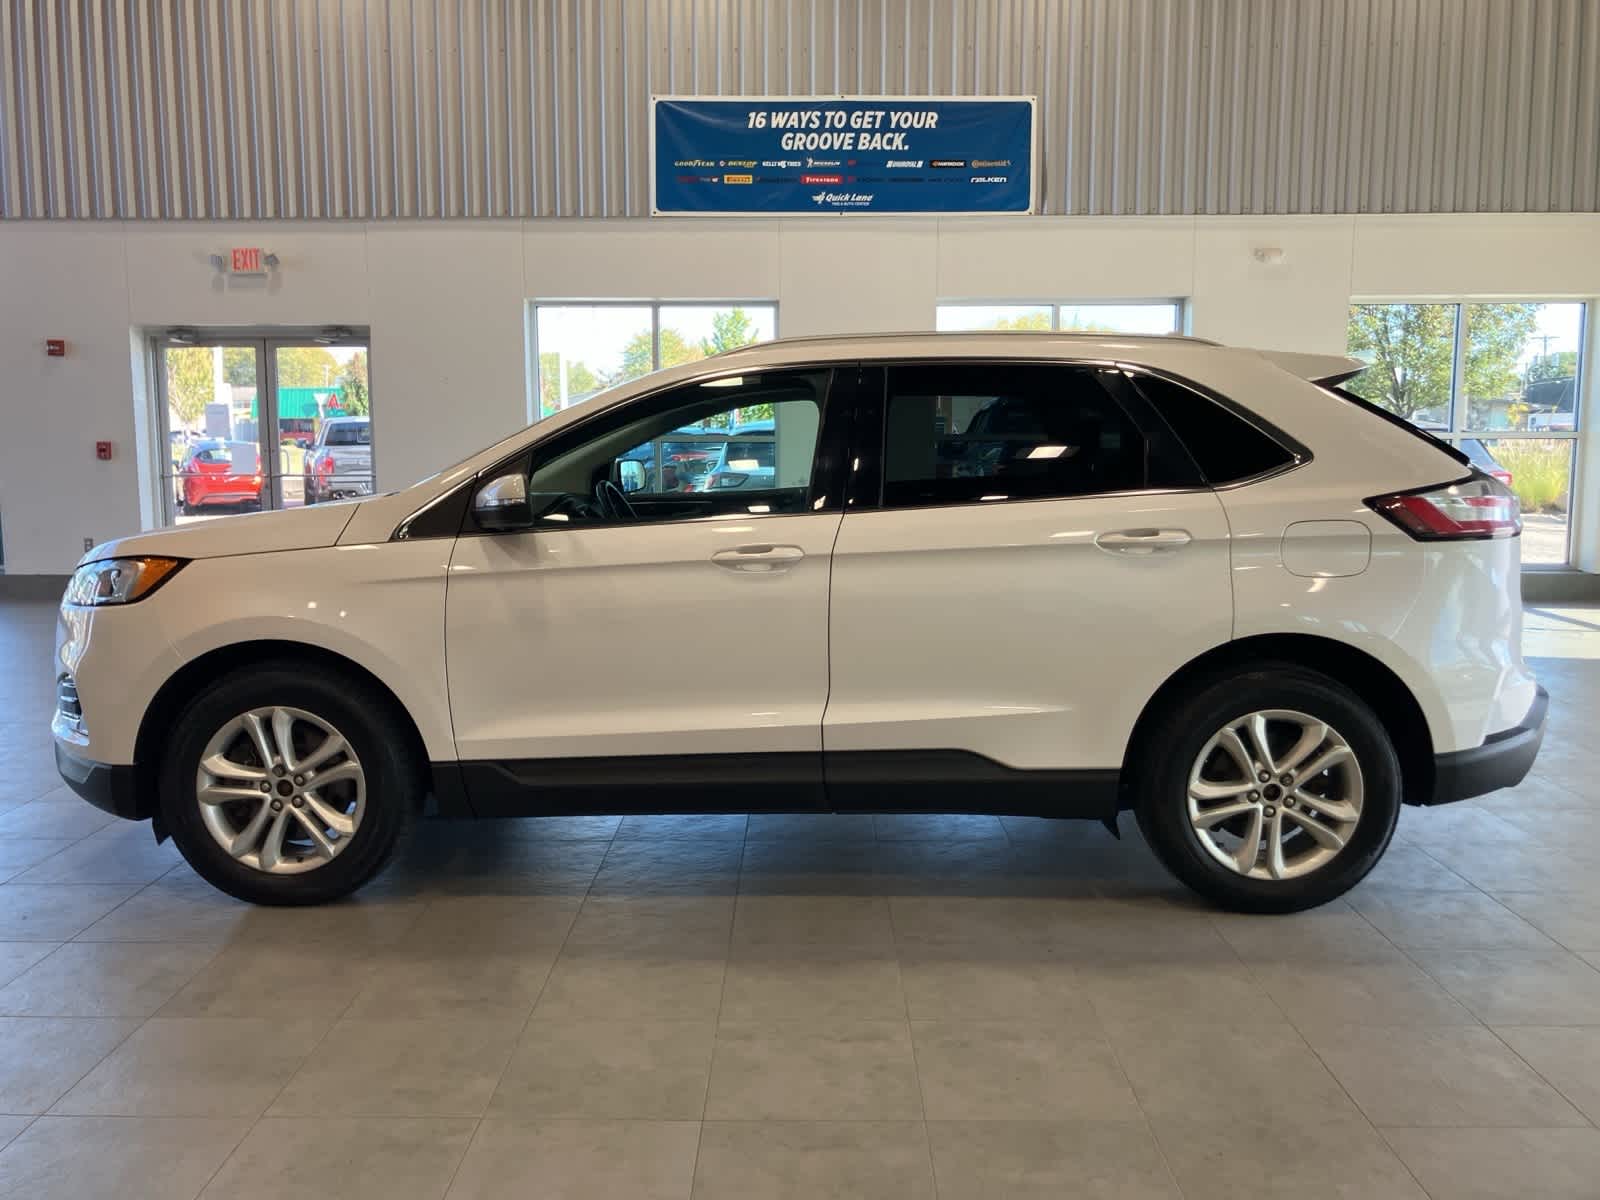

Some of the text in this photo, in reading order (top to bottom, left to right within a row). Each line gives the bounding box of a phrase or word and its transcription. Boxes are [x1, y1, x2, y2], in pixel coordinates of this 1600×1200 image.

[748, 111, 938, 129] 16 WAYS TO GET YOUR
[781, 133, 910, 151] GROOVE BACK.
[728, 160, 758, 168] DUNLOP
[805, 176, 839, 184] Firestone
[825, 192, 874, 202] Quick Lane
[232, 248, 260, 271] EXIT
